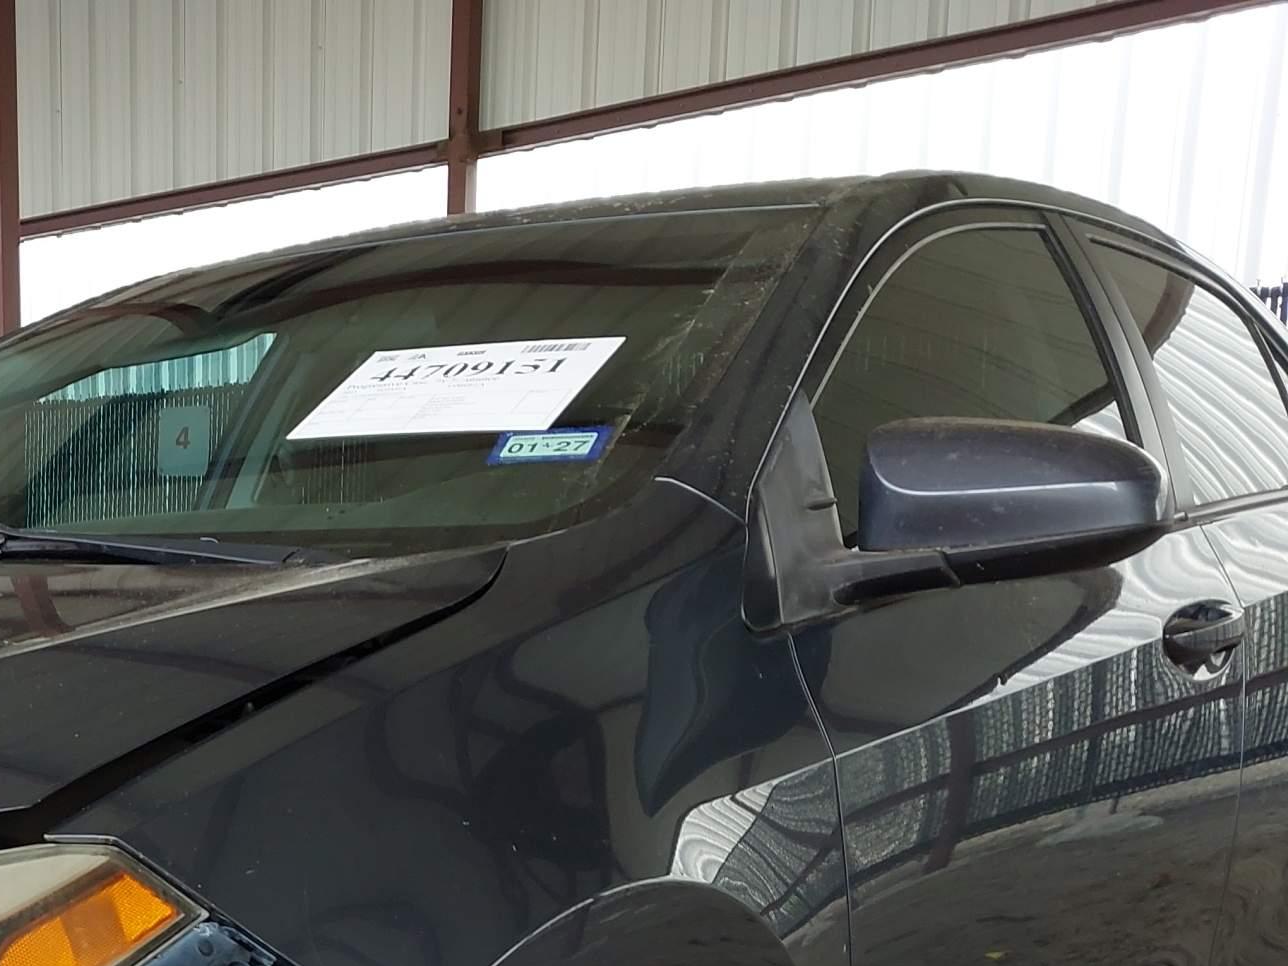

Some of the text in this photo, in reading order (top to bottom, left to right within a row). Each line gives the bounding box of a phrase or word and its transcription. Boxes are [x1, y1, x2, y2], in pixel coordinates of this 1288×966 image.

[370, 357, 567, 381] 44709151
[175, 425, 191, 449] 4
[507, 440, 589, 454] 01 27
